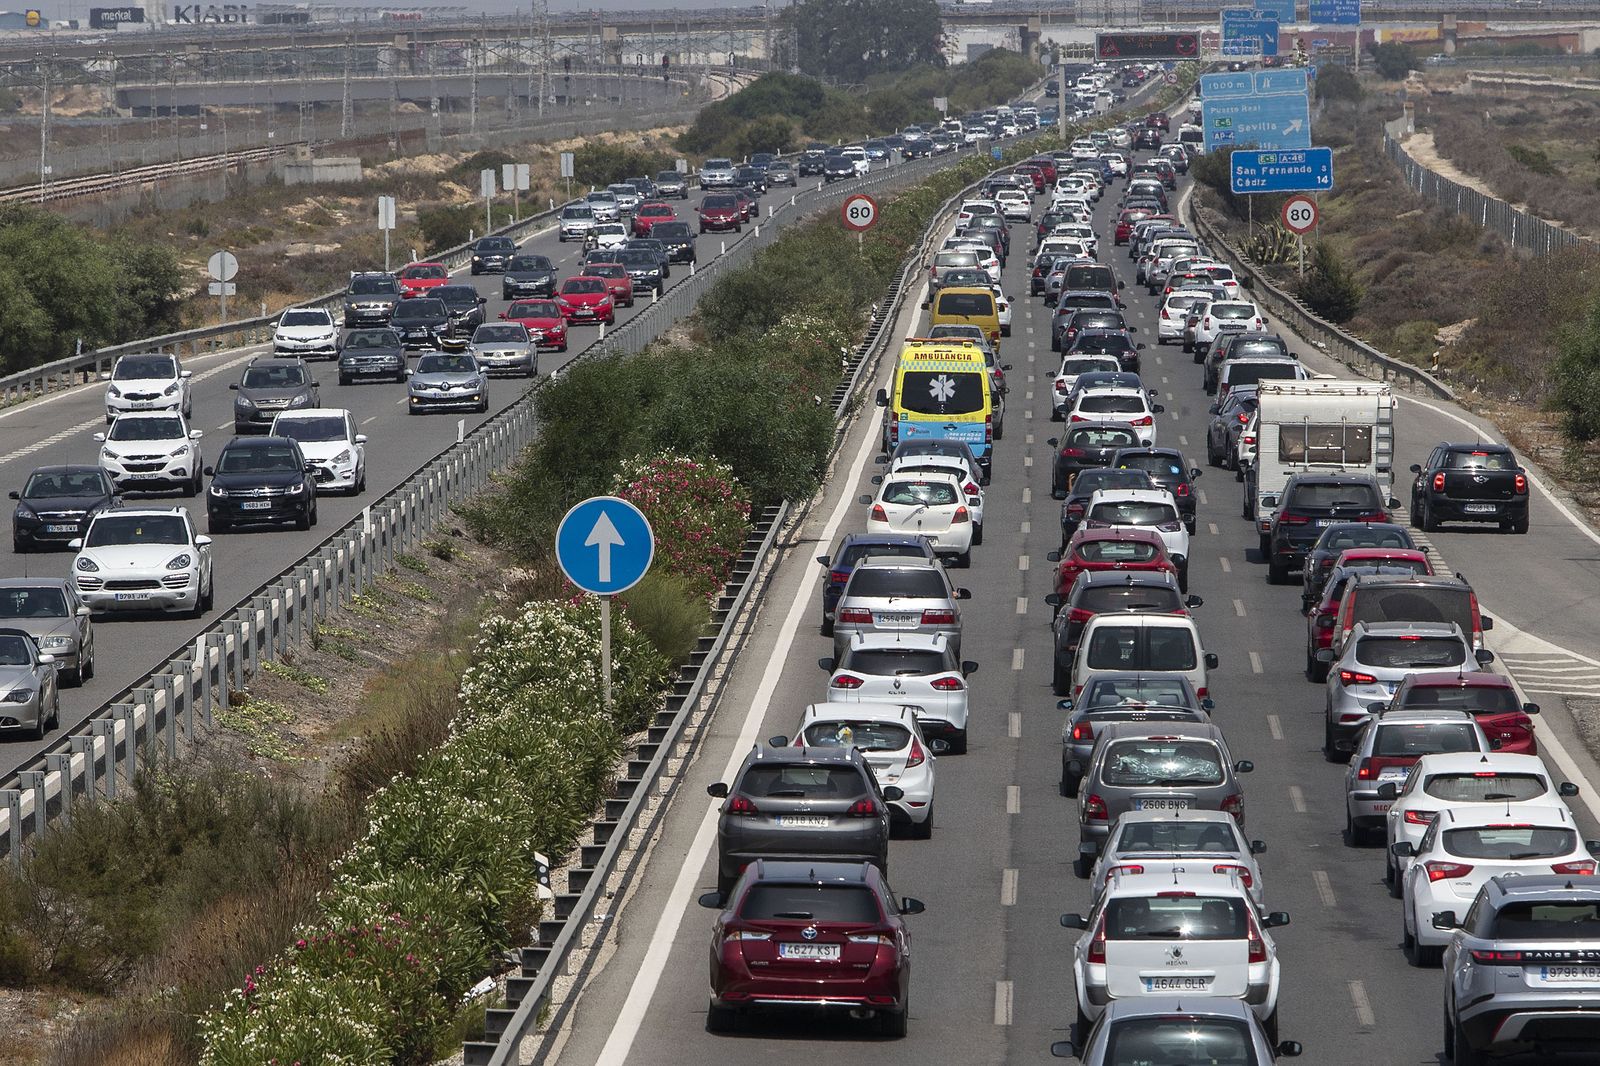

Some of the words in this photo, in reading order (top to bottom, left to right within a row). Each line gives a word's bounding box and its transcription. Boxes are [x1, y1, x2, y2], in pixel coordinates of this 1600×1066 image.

[174, 5, 247, 24] KIABI
[1238, 122, 1278, 132] Sevilla
[1260, 155, 1275, 163] E-5
[1236, 166, 1256, 175] San
[1262, 164, 1312, 174] Fernando
[1236, 177, 1267, 187] Cádiz
[1316, 175, 1329, 184] 14
[850, 207, 871, 219] 80
[1291, 208, 1311, 221] 80
[914, 353, 972, 361] AMBULANCIA
[882, 615, 900, 623] 2554
[1143, 801, 1166, 809] 2506
[808, 816, 826, 825] KNZ
[787, 945, 813, 955] 4627
[817, 945, 837, 956] KST
[1549, 967, 1578, 978] 9796
[1154, 978, 1181, 989] 4644
[1185, 978, 1206, 989] GLR
